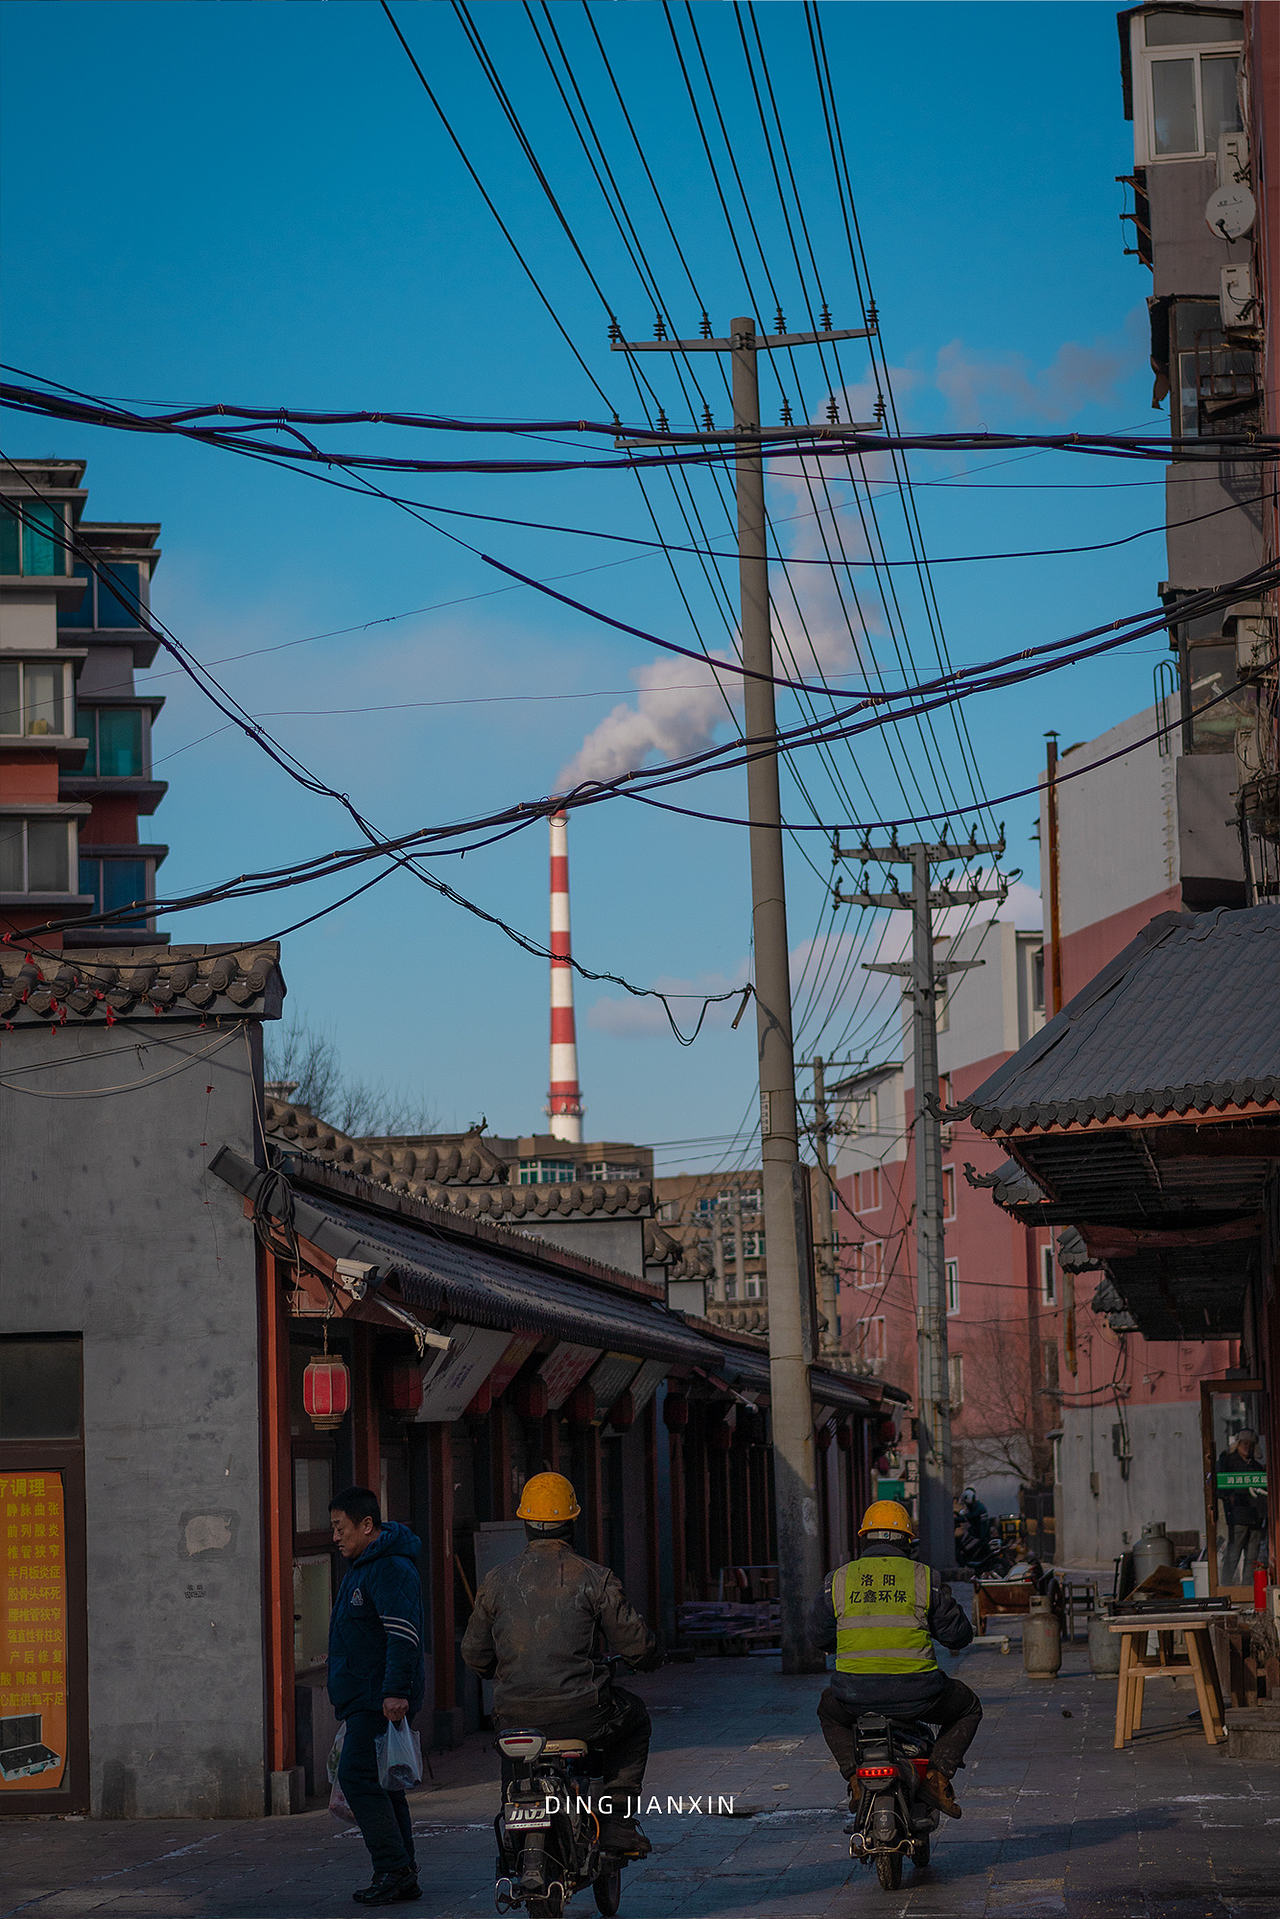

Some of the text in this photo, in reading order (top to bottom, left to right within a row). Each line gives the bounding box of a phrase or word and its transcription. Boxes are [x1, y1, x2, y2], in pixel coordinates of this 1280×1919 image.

[8, 1523, 59, 1538] 前列腺炎
[861, 1573, 897, 1587] 洛阳
[8, 1586, 61, 1601] 股骨头坏死
[849, 1589, 907, 1604] 亿鑫环保
[9, 1649, 63, 1664] 产后修复
